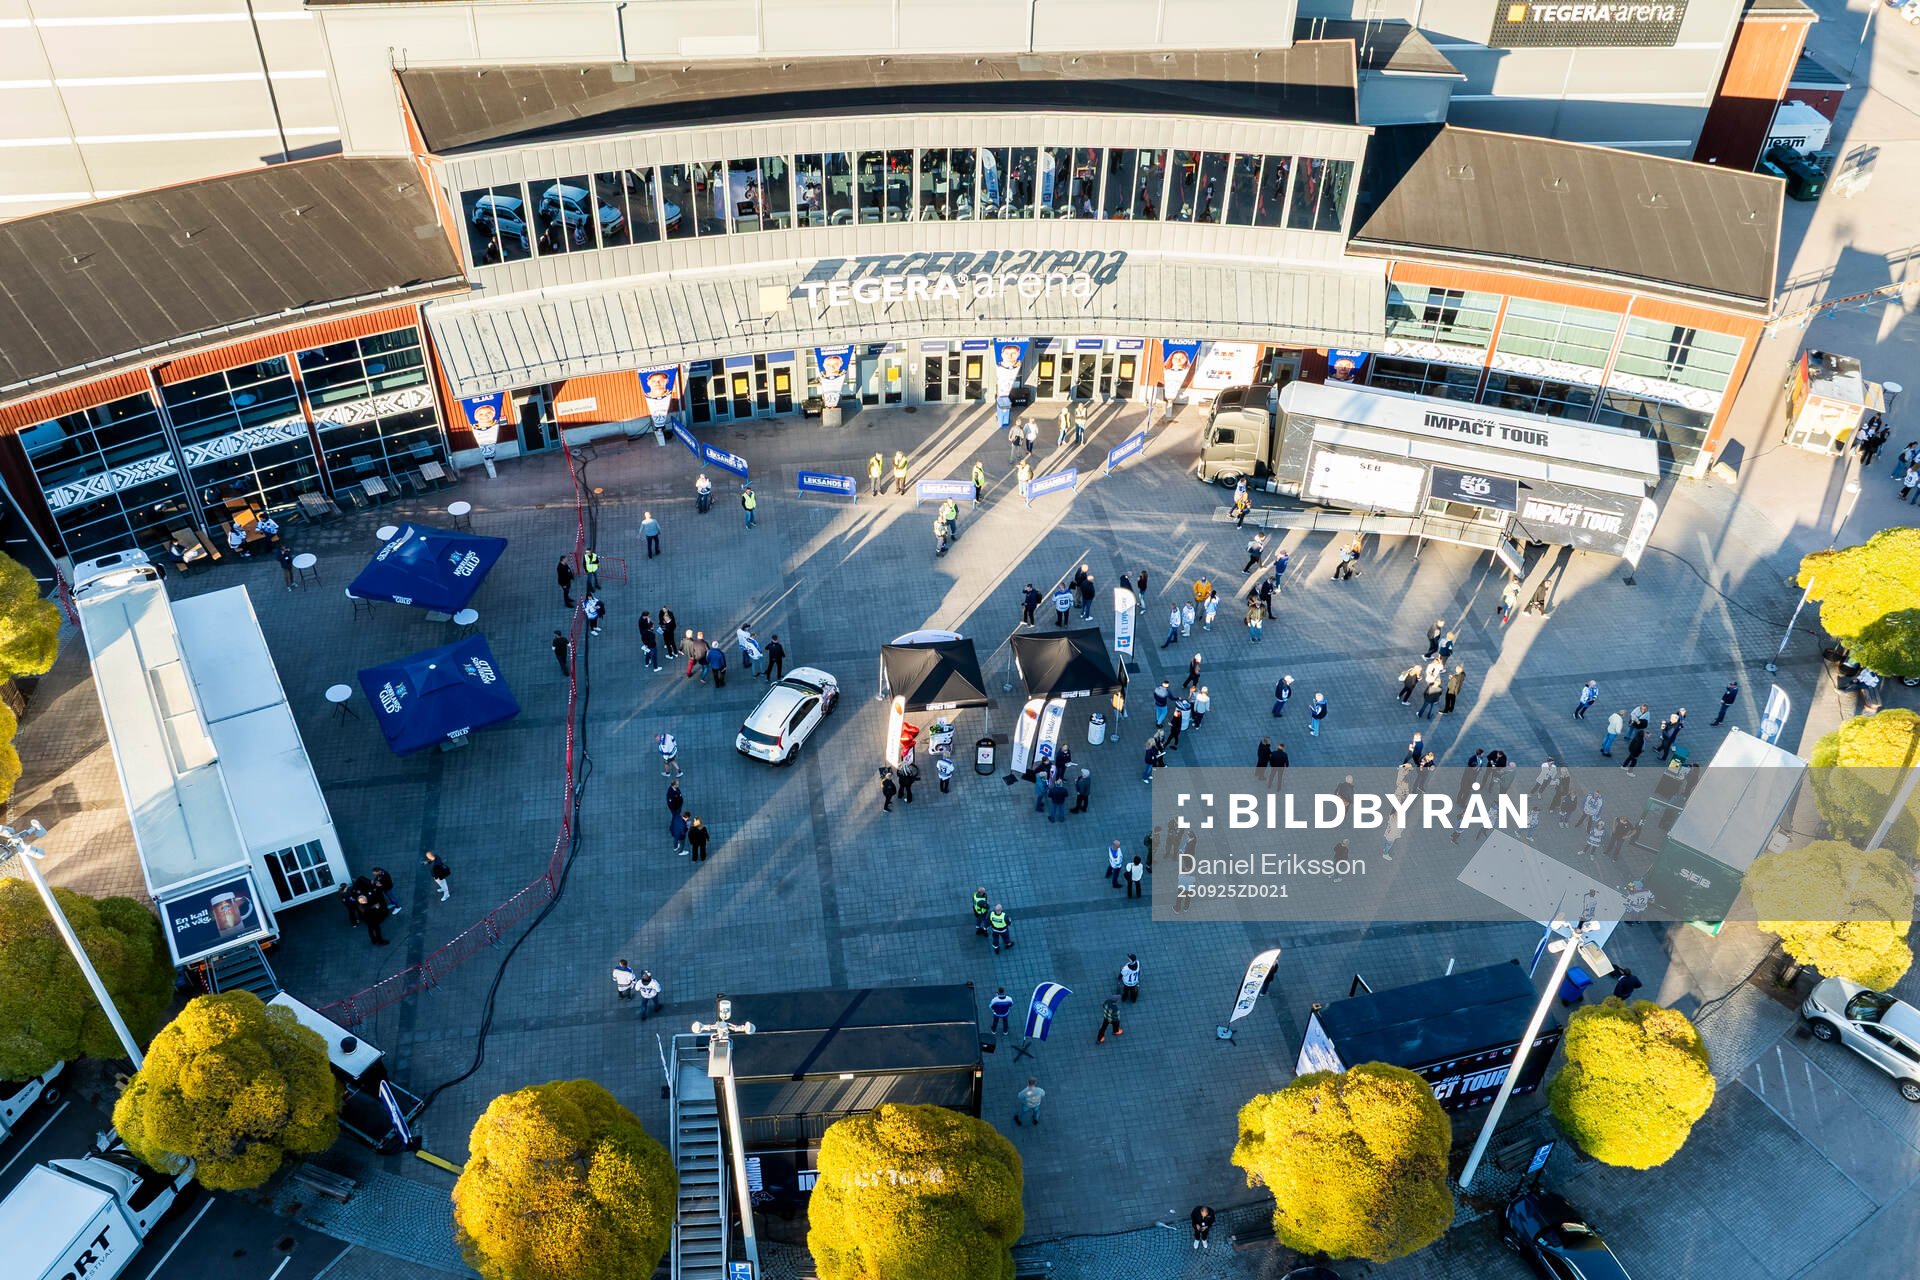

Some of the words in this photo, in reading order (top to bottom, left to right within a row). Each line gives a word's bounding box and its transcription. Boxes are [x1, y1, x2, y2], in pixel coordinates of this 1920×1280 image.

[1616, 5, 1675, 21] arena
[974, 271, 1094, 299] arena
[1424, 413, 1495, 437] IMPACT
[1499, 426, 1549, 447] TOUR
[1359, 463, 1382, 472] SEB
[803, 475, 841, 487] LEKSANDS
[1522, 502, 1581, 527] IMPACT
[1581, 510, 1623, 533] TOUR
[175, 917, 188, 925] En
[190, 909, 209, 920] kall
[176, 923, 191, 933] på
[735, 1263, 746, 1271] P
